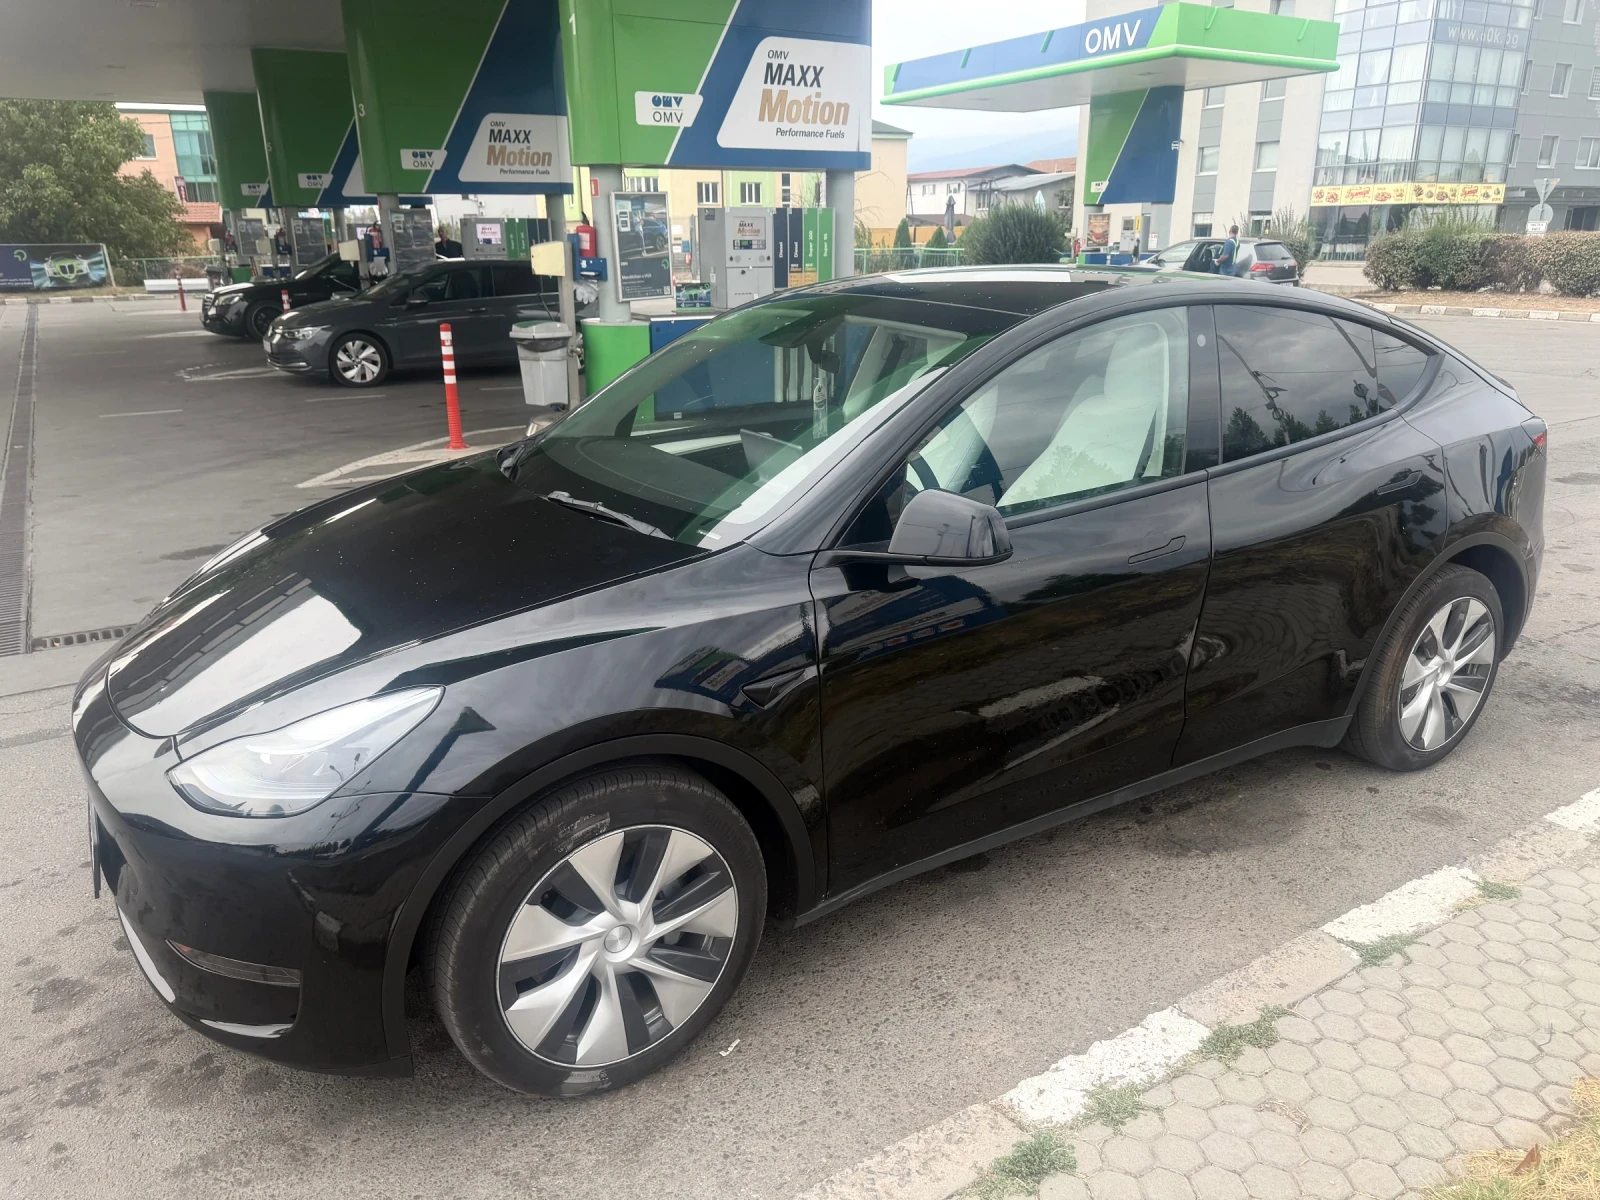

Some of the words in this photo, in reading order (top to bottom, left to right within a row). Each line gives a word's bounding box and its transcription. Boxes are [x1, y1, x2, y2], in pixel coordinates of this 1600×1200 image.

[568, 12, 577, 36] 1
[1085, 19, 1141, 54] OMV
[767, 49, 789, 60] OMV
[763, 62, 824, 88] MAXX
[358, 103, 366, 117] 3
[758, 88, 850, 126] Motion
[490, 120, 506, 128] OMV
[652, 110, 684, 123] OMV
[488, 128, 531, 144] MAXX
[775, 127, 824, 138] Performance
[825, 129, 845, 139] Fuels
[486, 144, 553, 167] Motion
[412, 160, 434, 168] OMV
